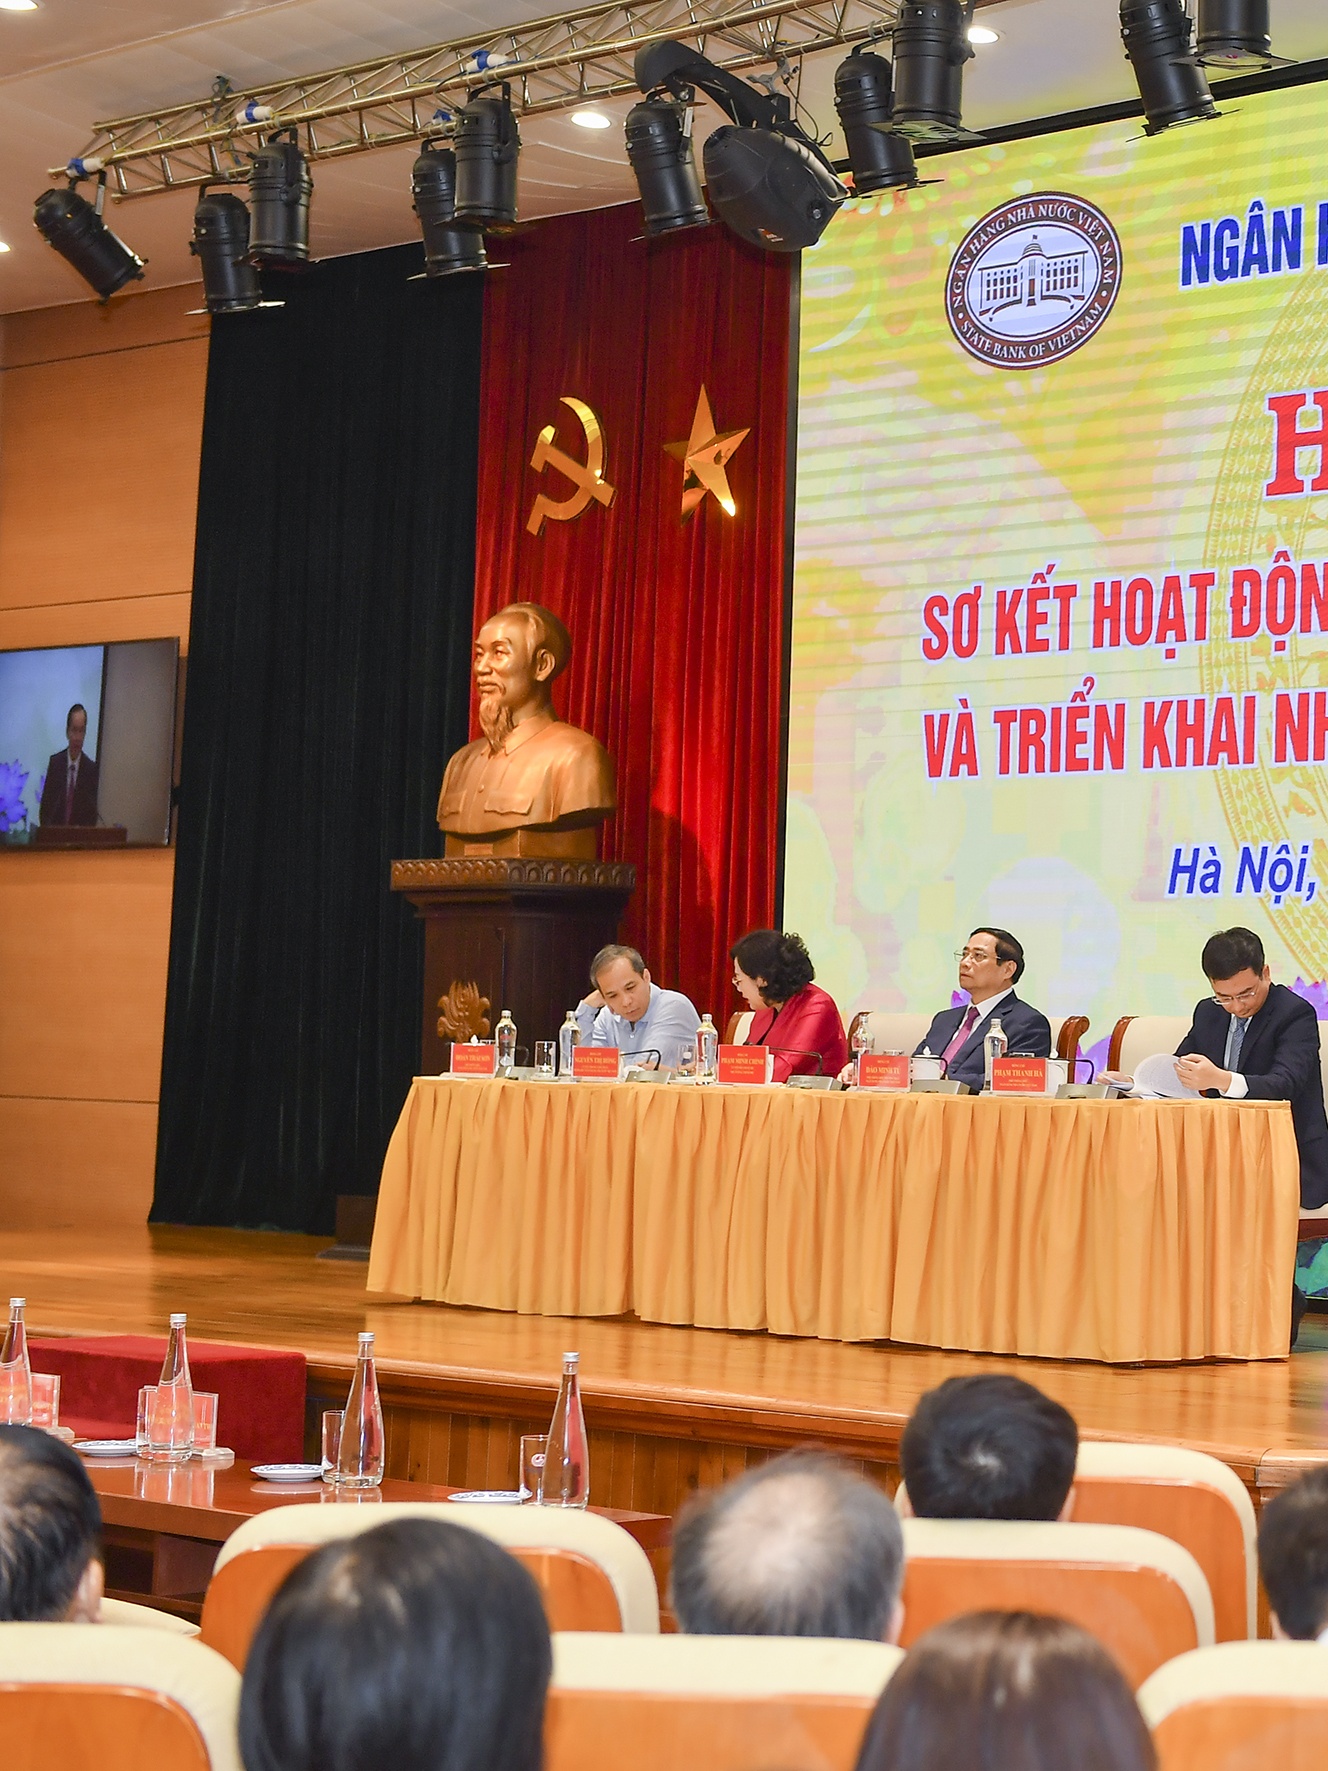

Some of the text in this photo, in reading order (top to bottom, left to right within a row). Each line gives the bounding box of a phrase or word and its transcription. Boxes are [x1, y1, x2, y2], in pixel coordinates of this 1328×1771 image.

[953, 202, 1114, 306] NGÂN HÀNG NHÀ NƯỚC VIỆT NAM
[1181, 200, 1302, 287] NGÂN
[961, 302, 1103, 359] STATE BANK OF VIETNAM
[923, 585, 983, 660] SƠ
[996, 565, 1077, 655] KẾT
[1093, 573, 1215, 659] HOẠT
[925, 696, 978, 777] VÀ
[994, 677, 1125, 775] TRIỂN
[1143, 696, 1256, 768] KHAI
[1168, 842, 1222, 895] Hà
[1235, 844, 1316, 904] Nội,
[994, 1069, 1011, 1079] PHẠM
